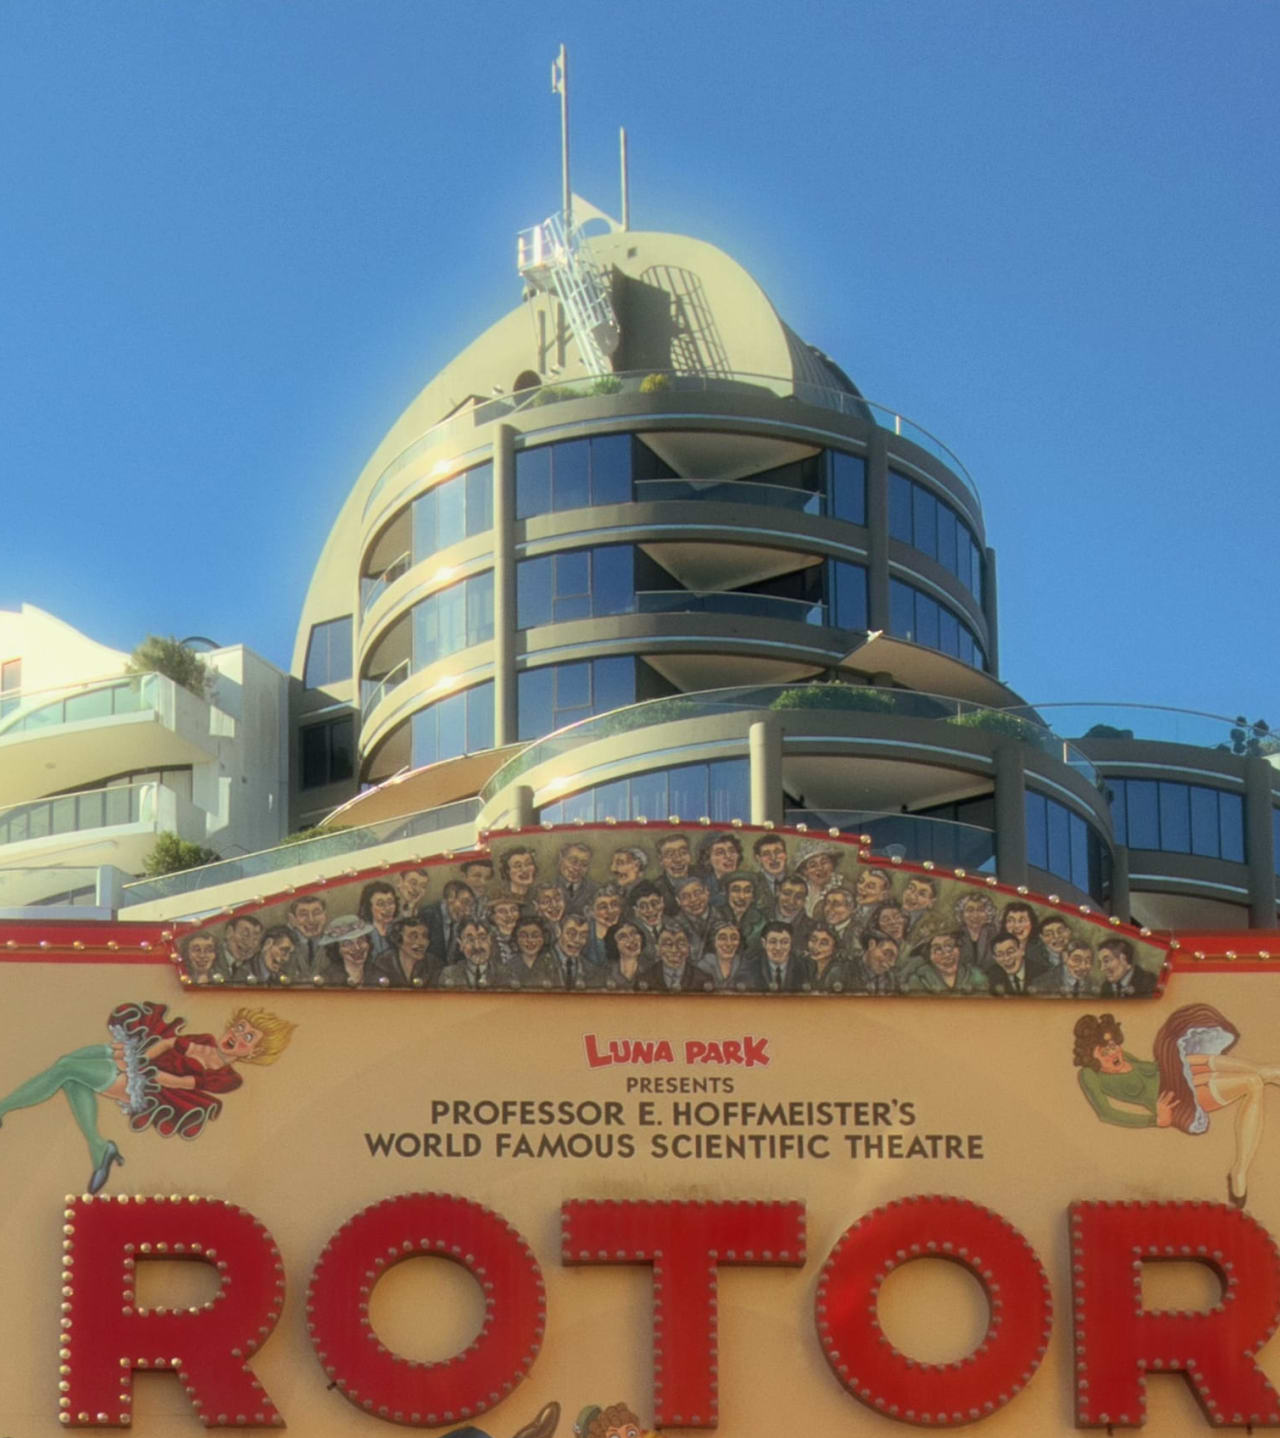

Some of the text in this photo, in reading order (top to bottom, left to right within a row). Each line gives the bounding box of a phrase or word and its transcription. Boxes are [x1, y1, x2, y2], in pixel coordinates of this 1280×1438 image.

[584, 1034, 770, 1068] LUNA PARK
[626, 1077, 734, 1093] PRESENTS
[431, 1099, 913, 1125] PROFESSOR E. HOFFMEISTER'S
[365, 1133, 982, 1159] WORLD FAMOUS SCIENTIFIC THEATRE
